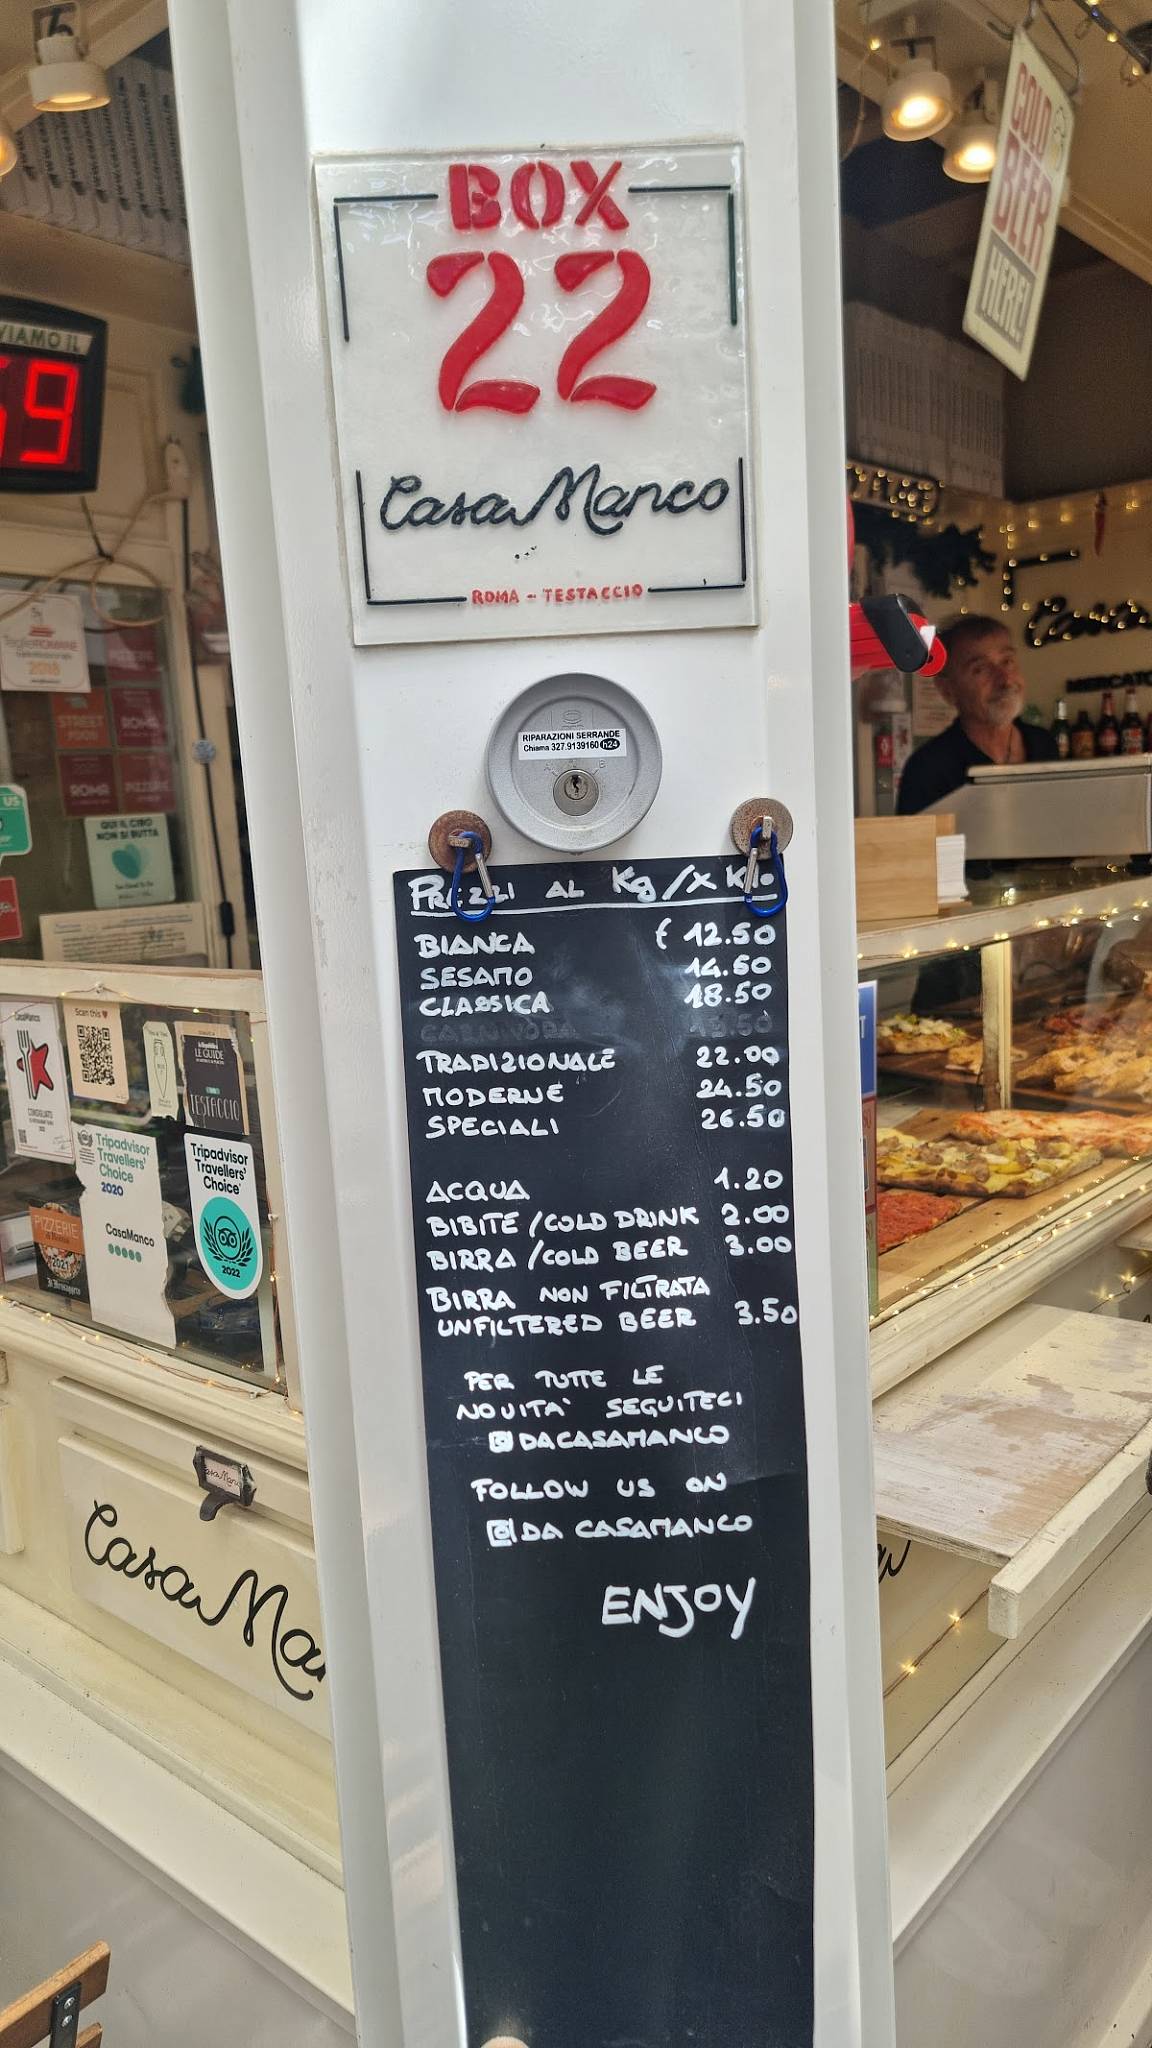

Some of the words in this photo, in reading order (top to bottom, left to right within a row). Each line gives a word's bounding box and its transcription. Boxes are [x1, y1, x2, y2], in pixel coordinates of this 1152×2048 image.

[449, 161, 630, 231] BOX
[992, 130, 1053, 273] BEER
[426, 250, 657, 414] 22
[471, 588, 520, 605] ROMA
[542, 584, 643, 604] TESTACCIO
[522, 732, 574, 742] RIPARAZIONI
[577, 730, 620, 739] SERRANDE
[551, 741, 599, 751] 327.9139160
[132, 829, 159, 839] BUTTA
[545, 880, 585, 899] AL
[414, 931, 536, 957] BIANCA
[684, 921, 776, 946] 12.50
[420, 966, 533, 990] SESAMO
[685, 955, 772, 979] 14.50
[75, 1008, 89, 1018] Scan
[419, 991, 551, 1017] CLASSICA
[684, 982, 773, 1009] 18.50
[416, 1048, 616, 1074] TRADIZIONALE
[697, 1046, 780, 1069] 22.00
[423, 1084, 564, 1108] MODERNE
[696, 1073, 782, 1099] 24.50
[190, 1094, 240, 1121] TESTACCIO
[425, 1116, 560, 1139] SPECIALI
[701, 1104, 785, 1130] 26.50
[96, 1132, 150, 1156] Tripadvisor
[190, 1142, 248, 1166] Tripadvisor
[99, 1163, 134, 1183] Choice
[203, 1176, 240, 1195] Choice
[426, 1179, 530, 1203] ACQUA
[715, 1167, 783, 1191] 1.20
[101, 1182, 124, 1197] 2020
[34, 1215, 79, 1239] PIZZERIE
[426, 1212, 519, 1237] BIBITE
[614, 1207, 700, 1230] DRINK
[722, 1203, 790, 1226] 2.00
[105, 1223, 155, 1248] CasaManco
[52, 1256, 69, 1270] 2021
[427, 1248, 516, 1272] BIRRA
[613, 1238, 689, 1263] BEER
[725, 1234, 792, 1257] 3.00
[221, 1265, 241, 1279] 2022
[425, 1286, 516, 1312] BIRRA
[539, 1285, 589, 1304] NON
[600, 1275, 711, 1302] FILTRATA
[437, 1315, 602, 1338] UNFILTERED
[618, 1308, 697, 1332] BEER
[734, 1297, 797, 1326] 3.50
[464, 1370, 515, 1391] PER
[535, 1368, 607, 1389] TUTTE
[632, 1364, 664, 1386] LE
[606, 1390, 743, 1420] SEGUITECI
[471, 1478, 589, 1502] FOLLOW
[617, 1478, 656, 1499] US
[685, 1471, 727, 1494] ON
[575, 1514, 753, 1541] CASAMANCO
[84, 1500, 326, 1701] CasaMa
[601, 1576, 757, 1641] ENJOY
